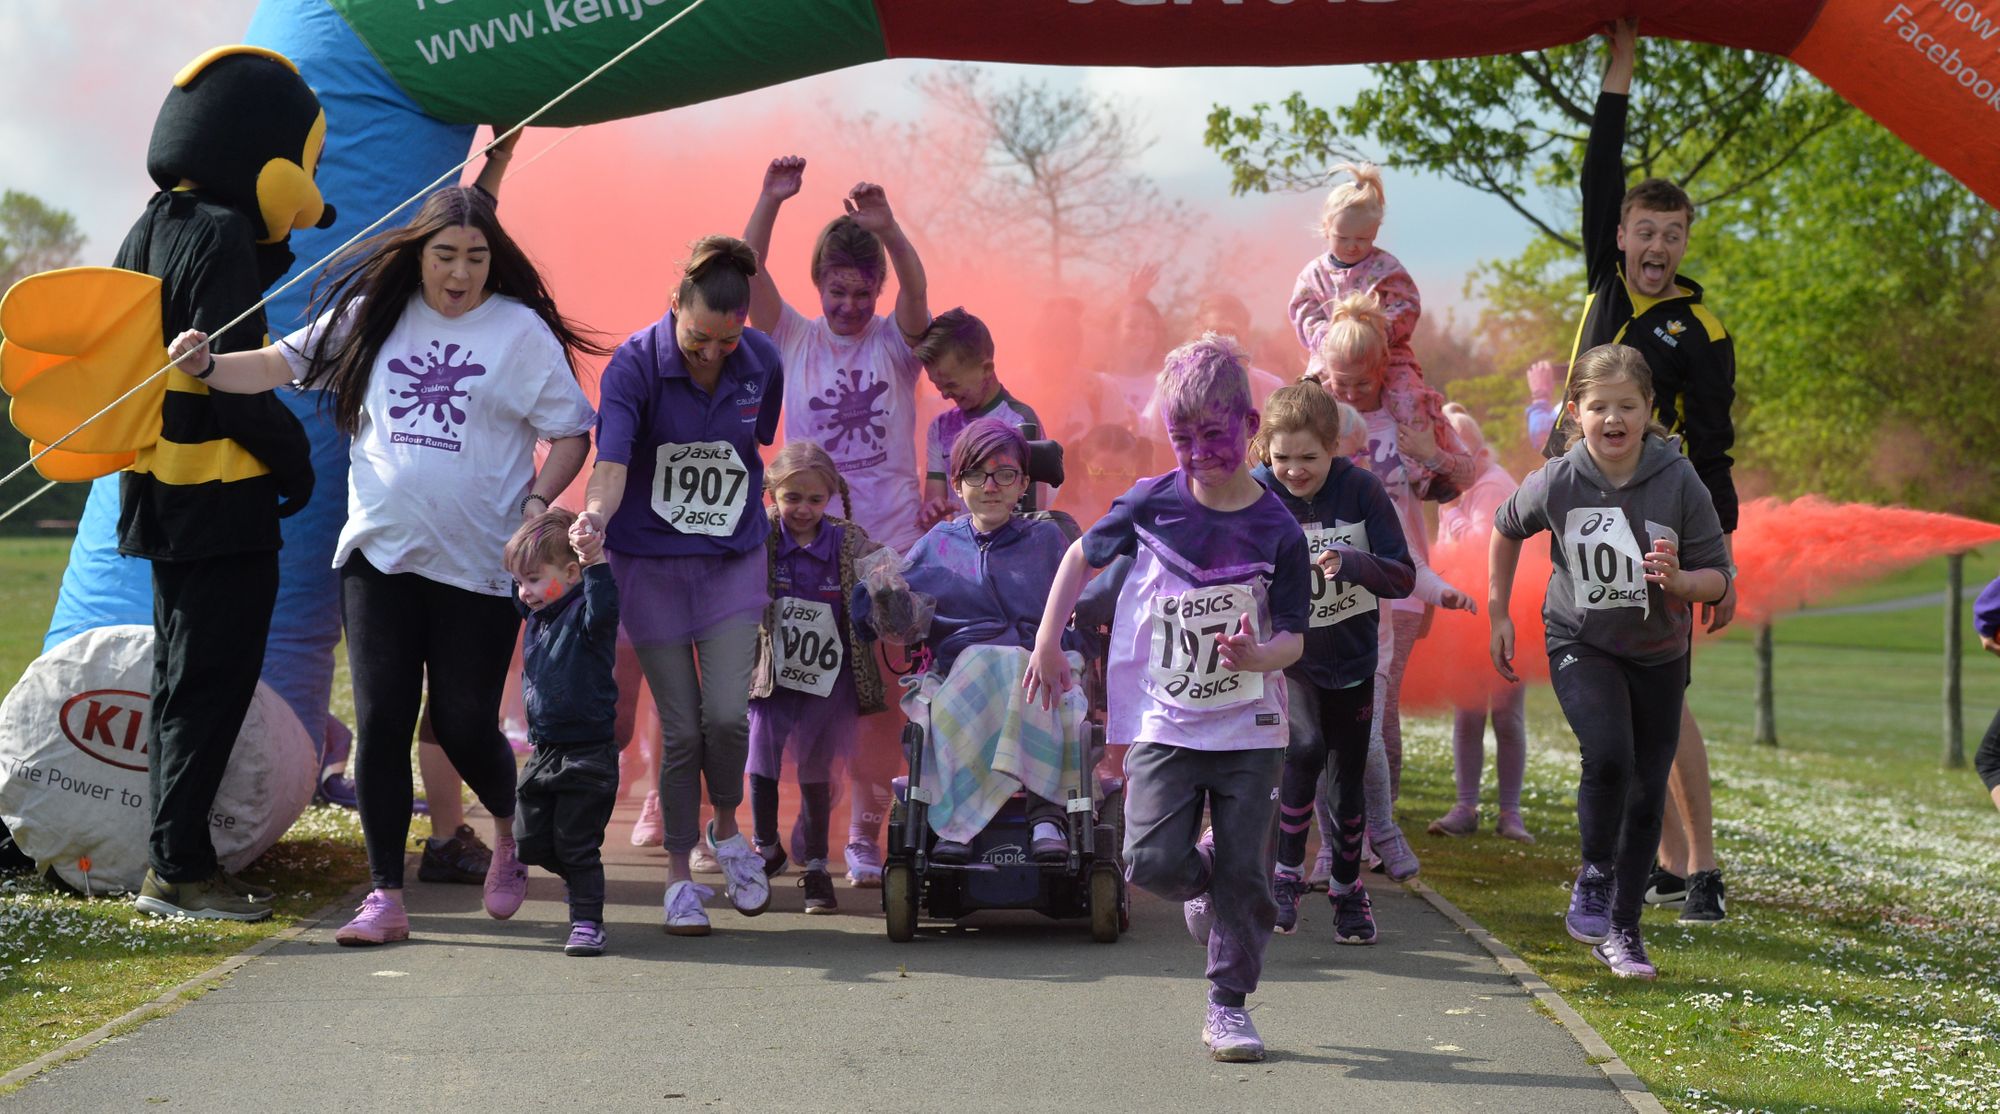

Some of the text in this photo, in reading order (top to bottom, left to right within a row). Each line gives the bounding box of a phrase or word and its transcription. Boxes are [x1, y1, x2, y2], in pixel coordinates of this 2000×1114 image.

[415, 0, 667, 65] www.kenj
[1883, 3, 2000, 112] Facebook
[393, 433, 459, 450] Colour Runner
[663, 465, 748, 507] 1907
[685, 510, 728, 526] asics
[1182, 593, 1234, 618] asics
[1161, 618, 1242, 675] 197
[1189, 674, 1240, 699] asics
[82, 700, 149, 754] KI
[10, 757, 142, 808] The Power to
